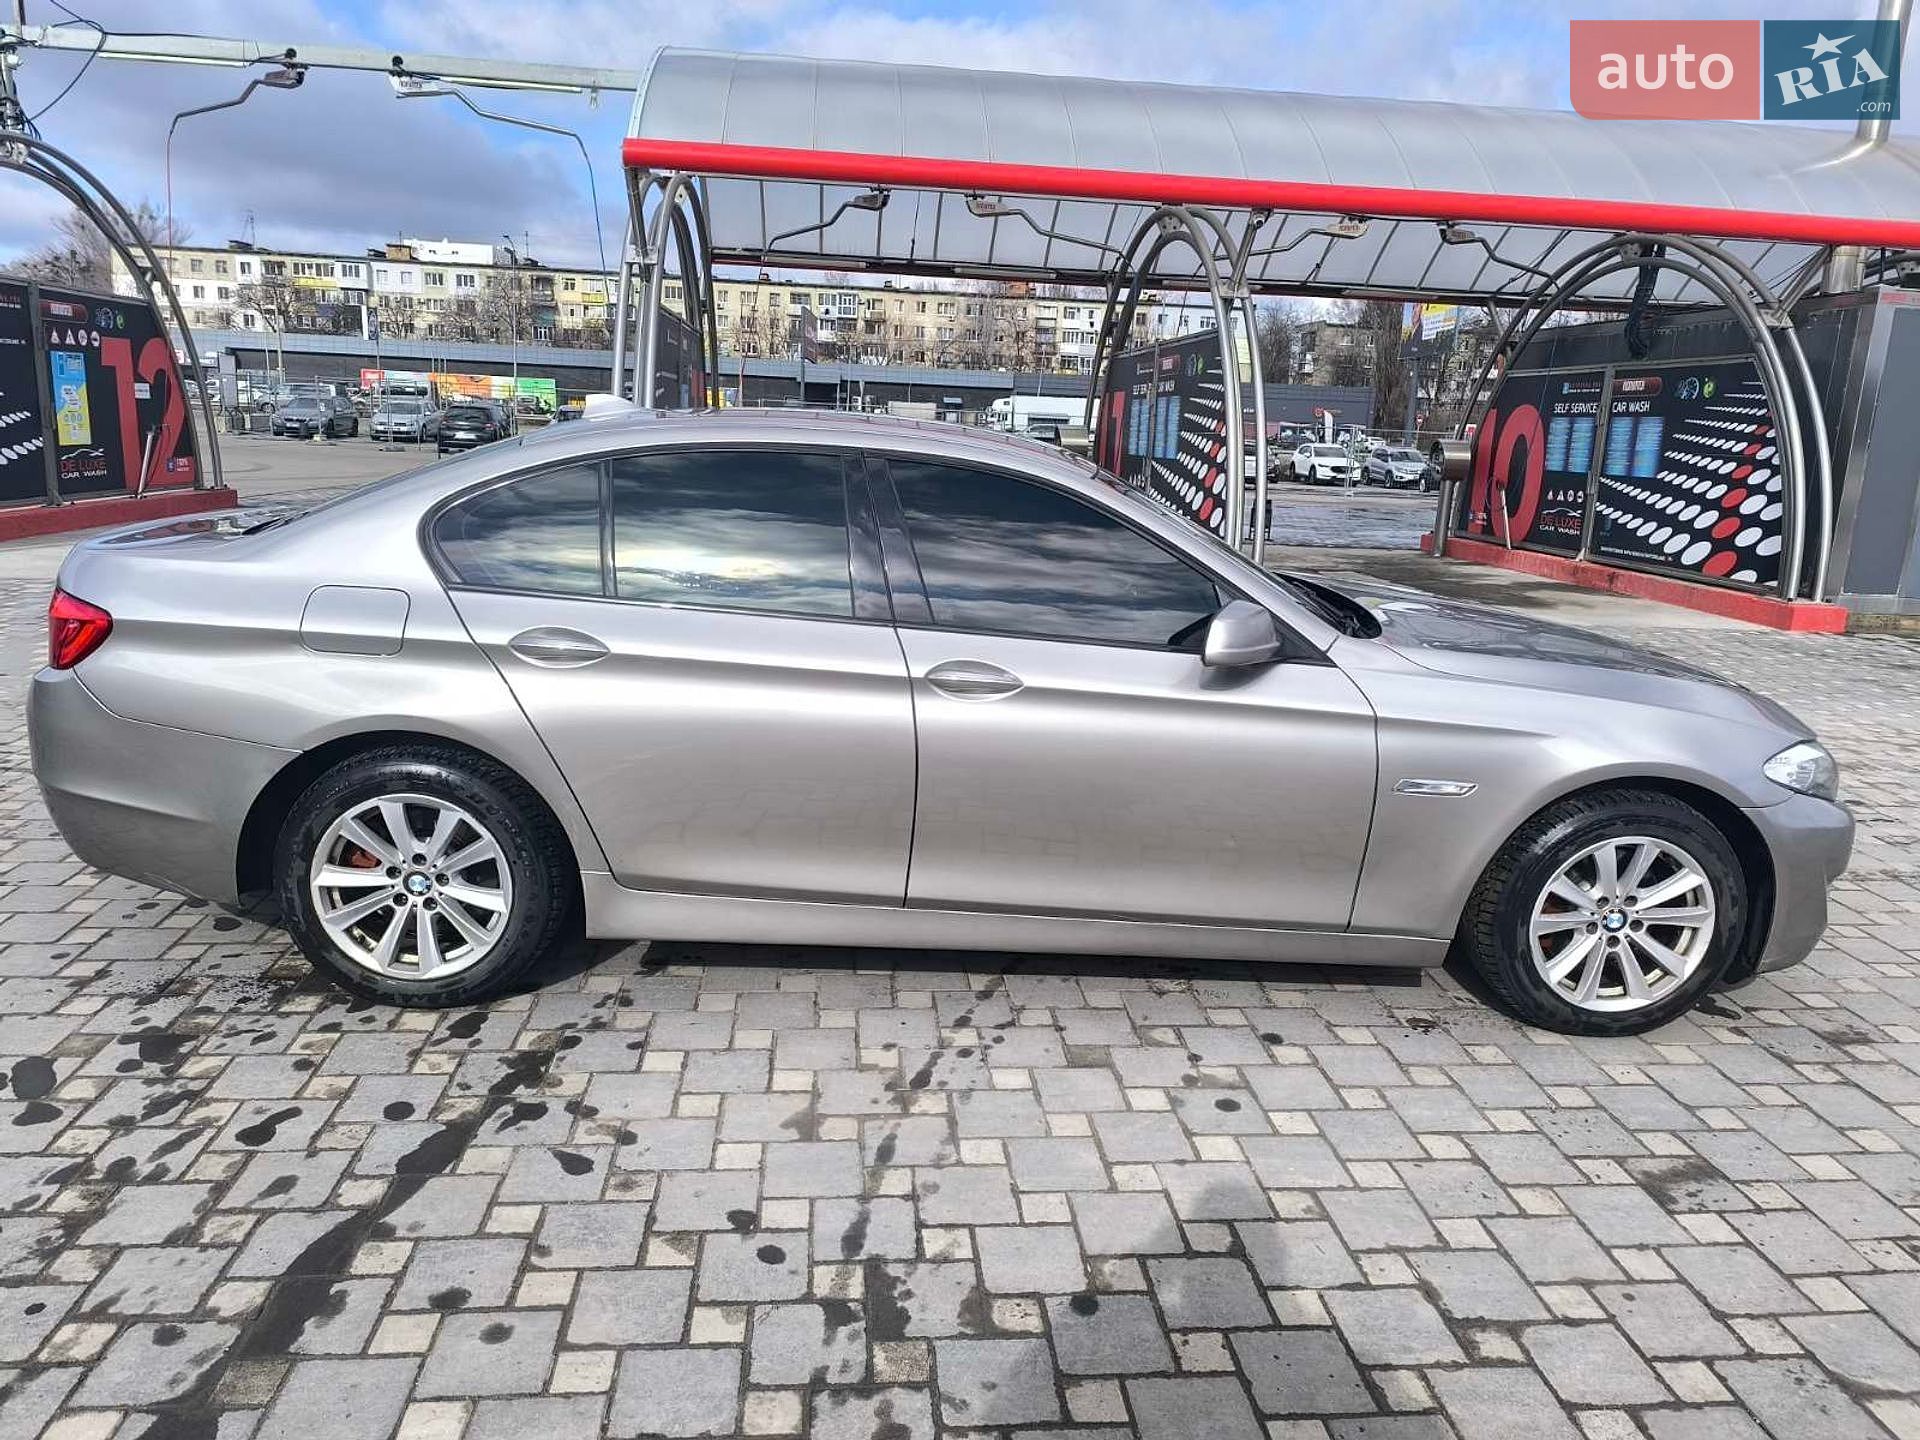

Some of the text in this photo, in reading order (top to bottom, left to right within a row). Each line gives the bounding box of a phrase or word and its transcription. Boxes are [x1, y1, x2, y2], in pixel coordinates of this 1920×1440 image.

[1553, 400, 1650, 413] SELF SERVICE CAR WASH
[101, 336, 196, 491] 12
[84, 469, 107, 477] WASH
[1467, 404, 1545, 541] 10
[1540, 524, 1580, 535] CAR WASH
